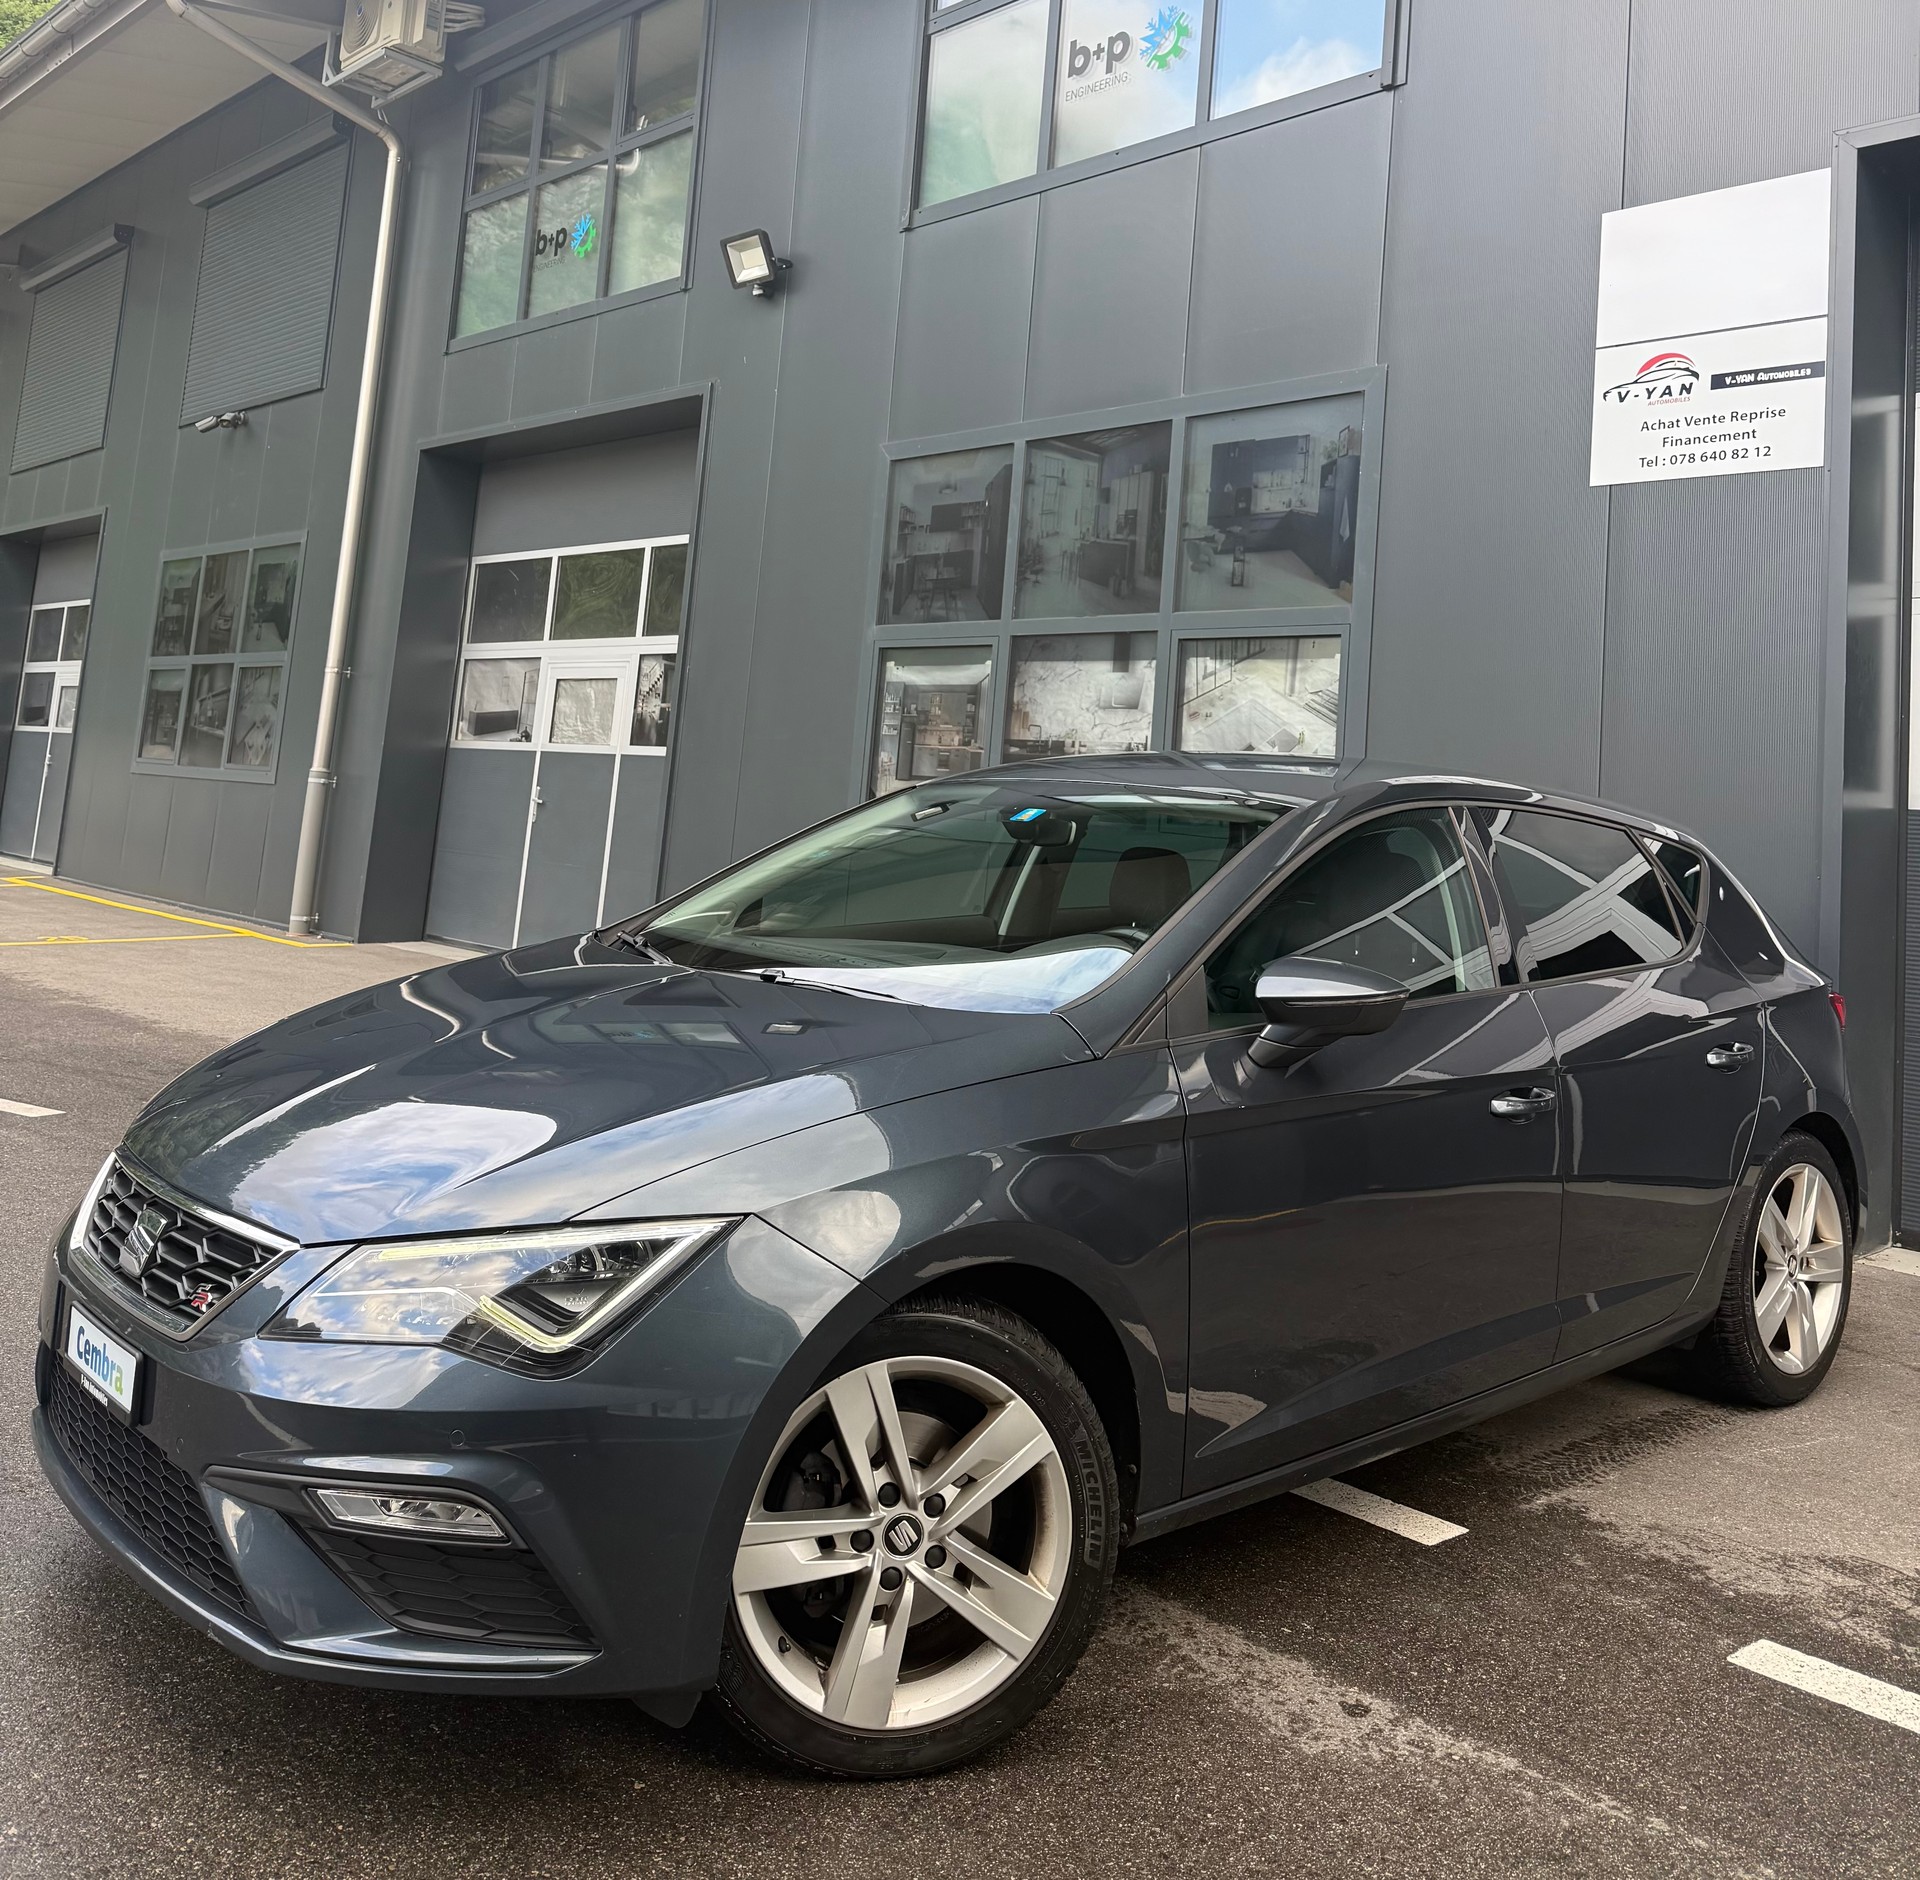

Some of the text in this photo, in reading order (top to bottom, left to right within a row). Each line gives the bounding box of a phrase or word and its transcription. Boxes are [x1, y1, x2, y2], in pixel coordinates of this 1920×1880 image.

[1067, 31, 1131, 78] b+p
[1065, 71, 1129, 102] ENGINEERING
[535, 227, 568, 256] b+p
[1617, 382, 1694, 403] V-YAN
[1647, 396, 1691, 406] AUTOMOBILES
[1640, 407, 1787, 432] Achat Vente Reprise
[1662, 429, 1758, 448] Financement
[1639, 456, 1658, 468] Tel
[1669, 453, 1697, 465] 078
[1700, 450, 1728, 462] 640
[1731, 448, 1750, 459] 82
[1754, 446, 1773, 457] 12
[76, 1325, 123, 1396] Cembra
[1074, 1440, 1103, 1563] MICHELIN
